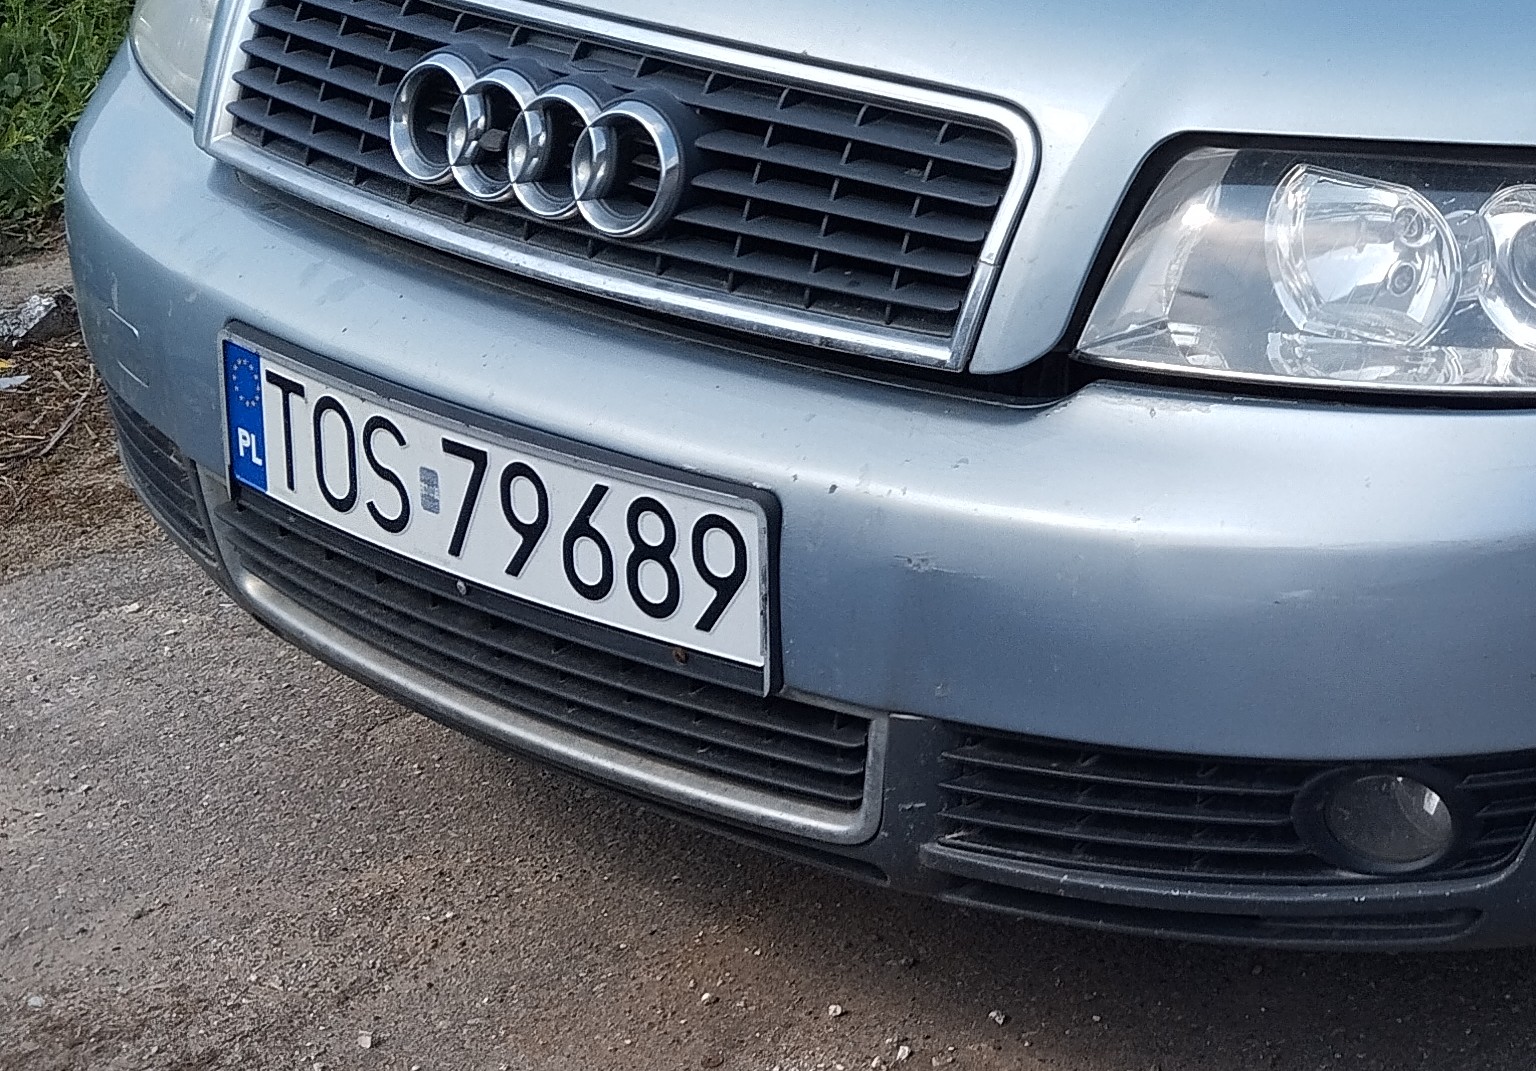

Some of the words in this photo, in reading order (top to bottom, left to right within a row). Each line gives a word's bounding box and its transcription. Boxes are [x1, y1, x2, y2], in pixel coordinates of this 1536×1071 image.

[237, 427, 263, 467] PL
[265, 369, 411, 534] TOS
[441, 438, 748, 633] 79689
